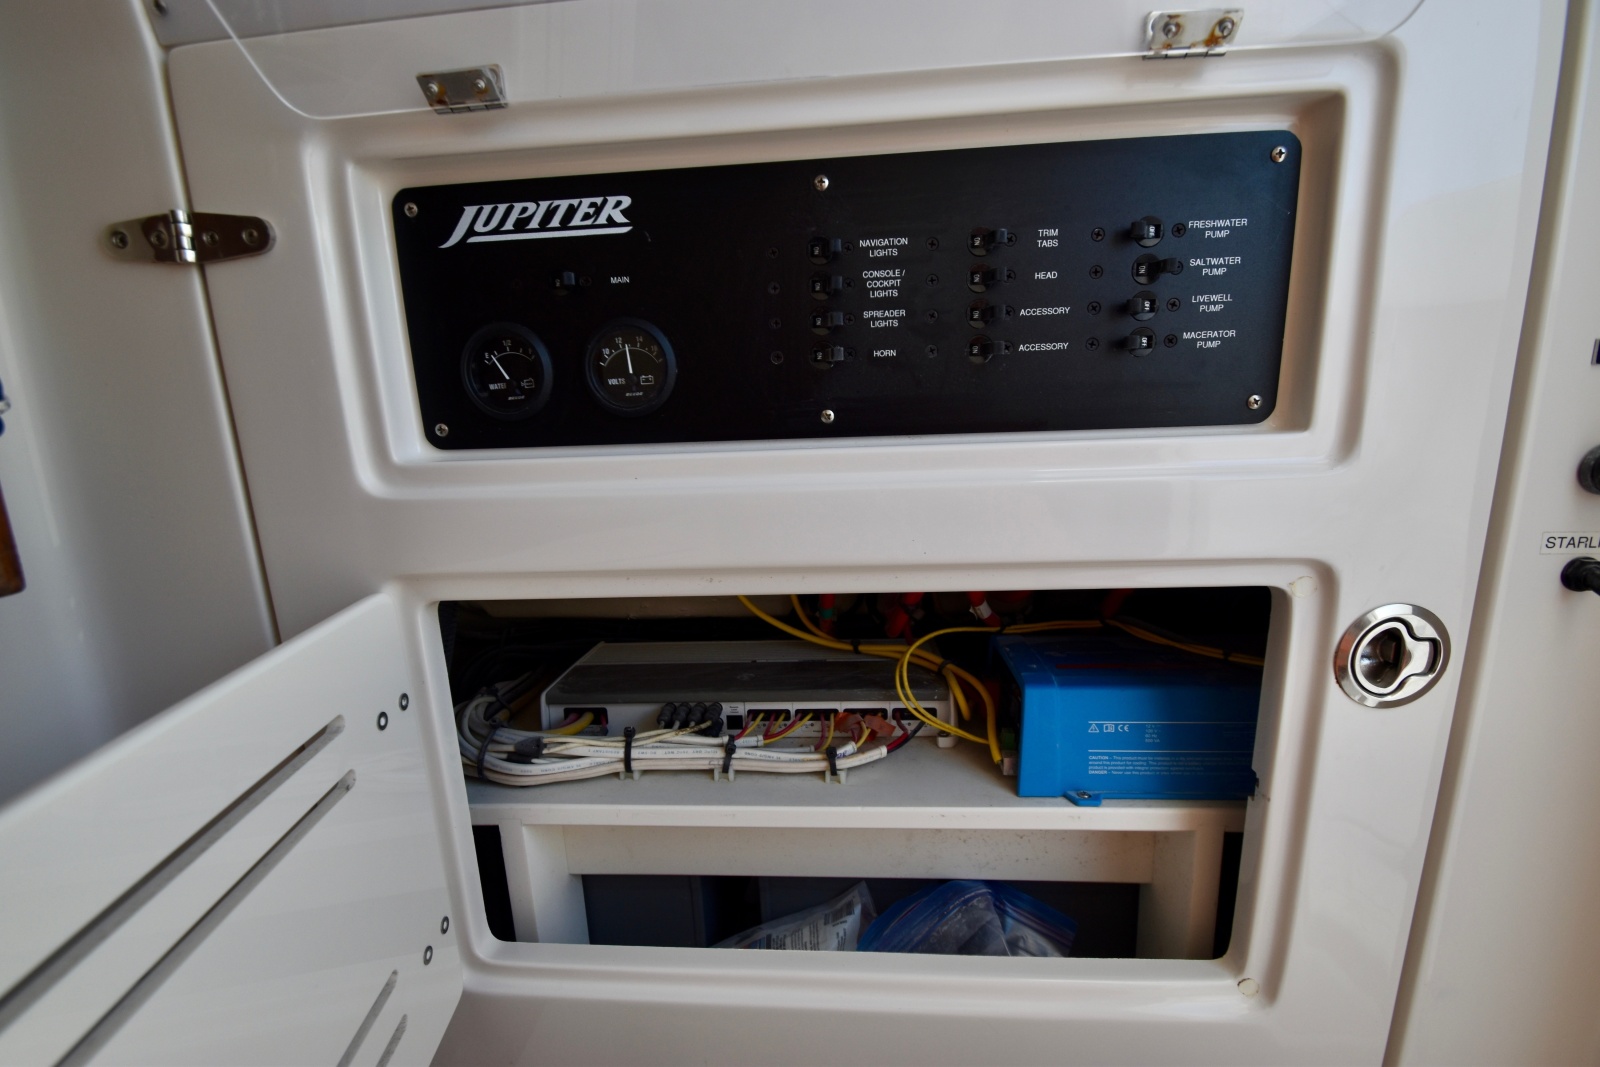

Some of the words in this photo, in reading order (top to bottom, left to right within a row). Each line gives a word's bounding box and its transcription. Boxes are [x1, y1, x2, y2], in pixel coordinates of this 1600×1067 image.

[438, 195, 633, 248] JUPITER
[1188, 218, 1247, 229] FRESHWATER
[1038, 229, 1059, 237] TRIM
[1205, 230, 1230, 239] PUMP
[859, 237, 908, 248] NAVIGATION
[1037, 239, 1058, 248] TABS
[869, 248, 898, 257] LIGHTS
[1189, 256, 1241, 267] SALTWATER
[862, 269, 900, 279] CONSOLE
[1035, 271, 1058, 280] HEAD
[1202, 267, 1227, 276] PUMP
[610, 275, 630, 284] MAIN
[866, 279, 901, 288] COCKPIT
[869, 289, 898, 298] LIGHTS
[1191, 293, 1233, 303] LIVEWELL
[1020, 307, 1071, 316] ACCESSORY
[1199, 304, 1224, 312] PUMP
[863, 309, 906, 319] SPREADER
[870, 319, 899, 328] LIGHTS
[1183, 330, 1236, 340] MACERATOR
[1018, 342, 1069, 352] ACCESSORY
[1196, 341, 1221, 349] PUMP
[873, 349, 897, 357] HORN
[607, 378, 626, 386] VOLTS
